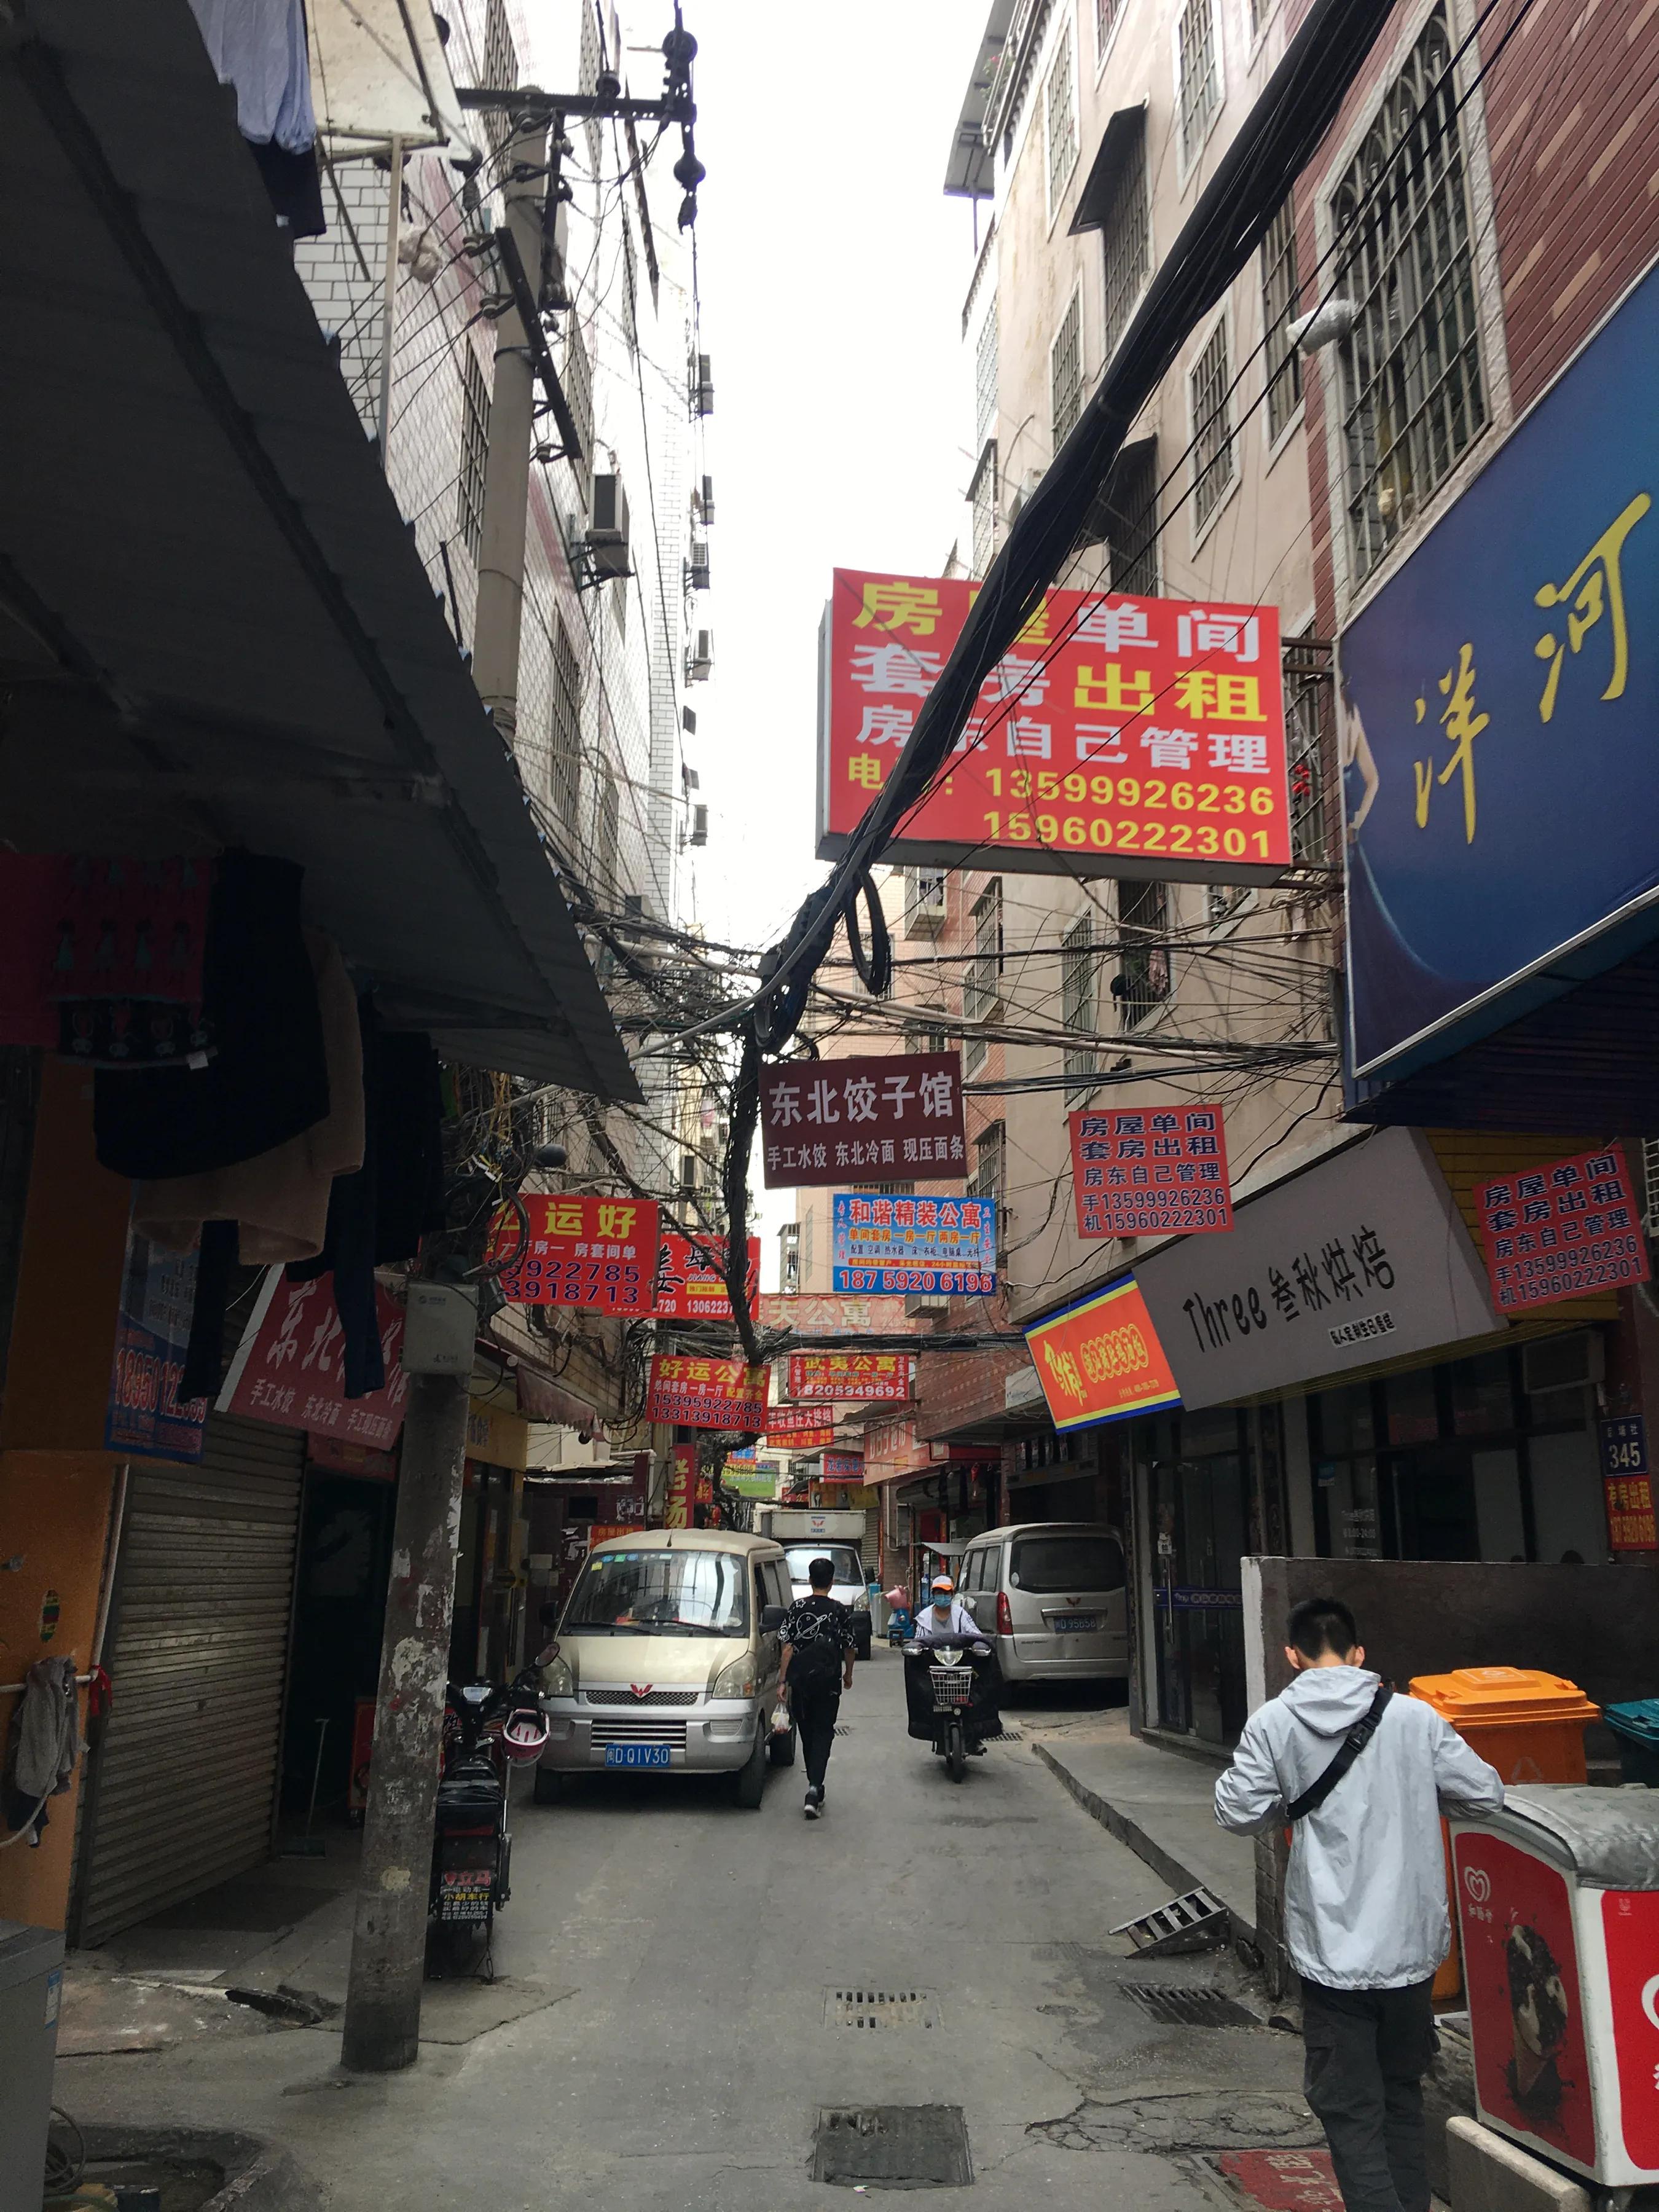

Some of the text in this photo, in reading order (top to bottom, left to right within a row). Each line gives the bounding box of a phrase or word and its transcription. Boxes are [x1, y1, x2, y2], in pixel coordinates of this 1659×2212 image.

[1414, 492, 1651, 844] 洋河
[986, 767, 1274, 816] 13599926236
[983, 810, 1270, 858] 15960222301
[769, 1072, 953, 1127] 东北饺子馆
[1078, 1112, 1215, 1137] 房屋单间
[767, 1134, 963, 1171] 手工水饺 东北冷面 现压面条
[1080, 1135, 1219, 1161] 套房出租
[1084, 1161, 1221, 1186] 房东自己管理
[1484, 1153, 1618, 1209] 房屋单间
[849, 1198, 981, 1229] 和谐精装公寓
[1487, 1179, 1626, 1233] 套房出租
[849, 1227, 980, 1244] 单间套房 一房一厅 两房一厅
[1494, 1207, 1631, 1260] 房东自己管理
[839, 1271, 992, 1292] 187 5920 6196
[1183, 1287, 1267, 1352] Three
[659, 1359, 767, 1387] 好运公寓
[250, 1379, 296, 1413] 手工水饺
[654, 1379, 688, 1394] 单间套房
[689, 1383, 723, 1397] 一房一厅
[652, 1407, 761, 1428] 13313918713
[654, 1393, 763, 1414] 15395922785
[1609, 1441, 1641, 1469] 345
[458, 1870, 491, 1886] 立马
